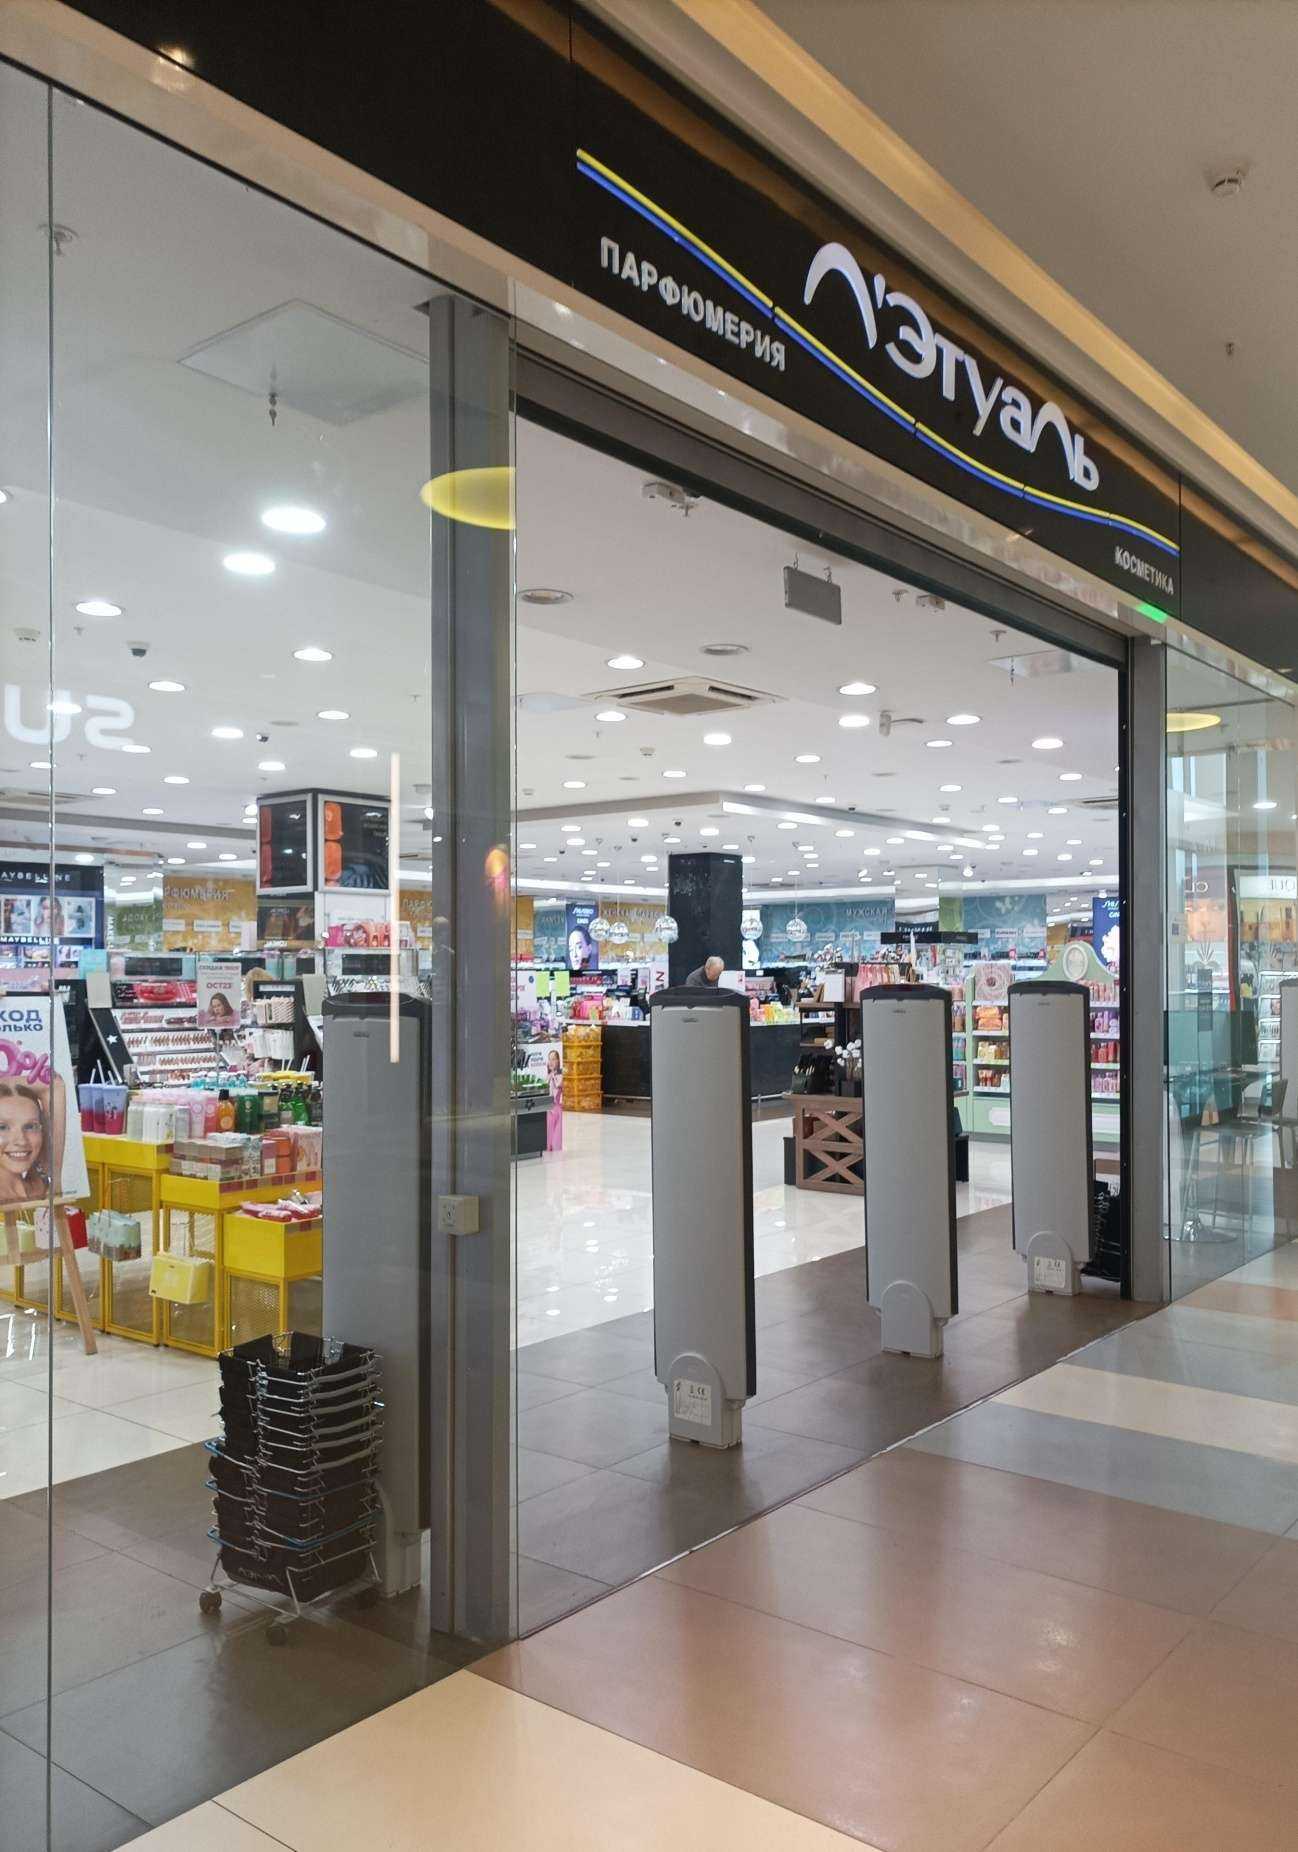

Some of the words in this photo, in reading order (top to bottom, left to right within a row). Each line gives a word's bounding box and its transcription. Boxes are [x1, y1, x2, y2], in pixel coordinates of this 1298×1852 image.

[600, 236, 786, 373] ПАРФЮМЕРИЯ
[1114, 545, 1175, 596] КОСМЕТИКА
[1, 871, 72, 883] AYBELLNE
